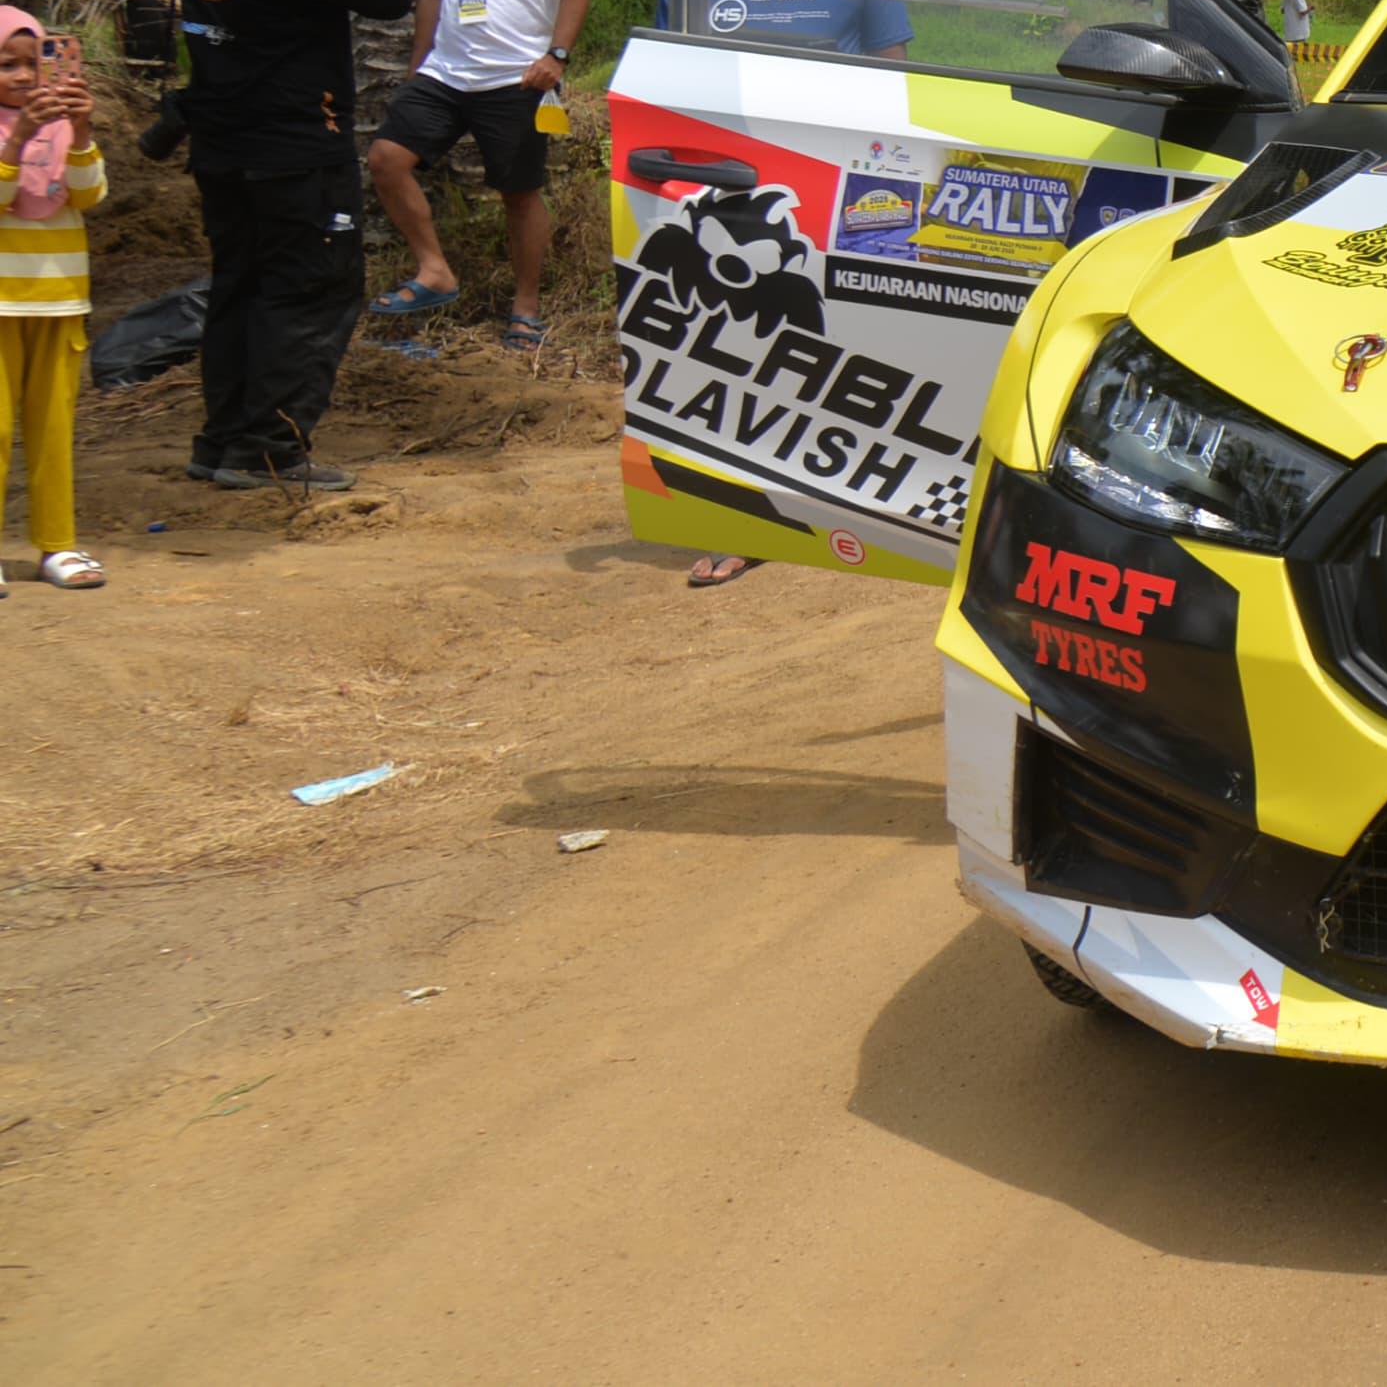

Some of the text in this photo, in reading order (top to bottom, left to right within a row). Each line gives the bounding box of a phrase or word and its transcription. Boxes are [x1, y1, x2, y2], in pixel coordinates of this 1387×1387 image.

[714, 7, 742, 22] HS
[945, 167, 1021, 191] SUMATERA
[1022, 177, 1069, 196] UTARA
[928, 183, 1070, 236] RALLY
[835, 269, 942, 304] KEJUARAAN
[1015, 541, 1177, 636] MRF
[1030, 620, 1148, 694] TYRES
[1243, 974, 1270, 1012] TOW
